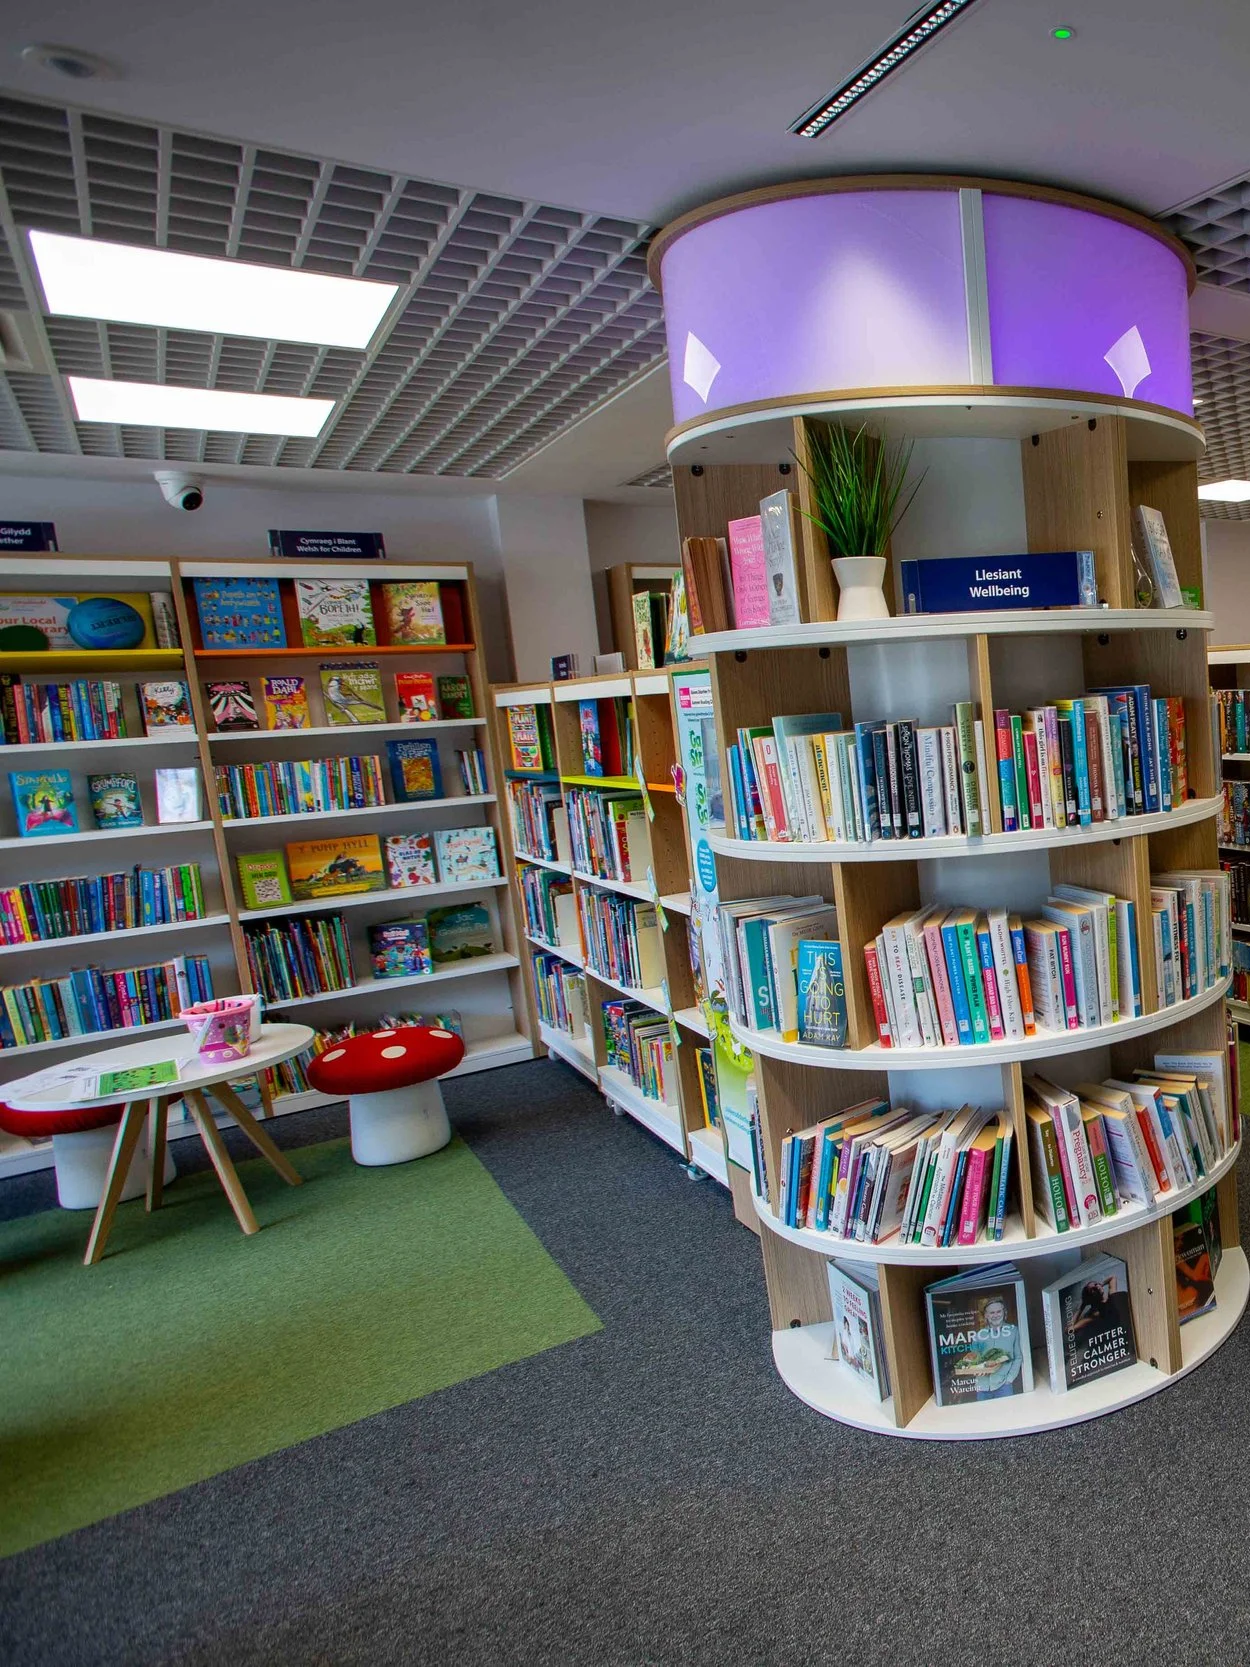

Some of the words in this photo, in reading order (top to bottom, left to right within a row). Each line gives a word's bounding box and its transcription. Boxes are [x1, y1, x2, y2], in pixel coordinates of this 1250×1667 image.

[300, 538, 333, 547] Cymraeg
[337, 538, 357, 546] Blant
[975, 568, 1022, 581] Llesiant
[969, 584, 1030, 599] Wellbeing
[23, 616, 57, 625] Local
[270, 679, 299, 688] ROALD
[272, 685, 301, 696] DAHL
[1128, 695, 1136, 717] ADAM
[1075, 703, 1083, 742] Mindfulness
[1129, 717, 1137, 740] PEATY
[923, 735, 935, 769] Mindful
[1000, 730, 1008, 758] COMFORT
[946, 750, 955, 792] PERFORMANCE
[907, 934, 915, 954] CELERY
[1014, 937, 1022, 950] Allen
[807, 951, 836, 967] THIS
[893, 944, 899, 953] TO
[898, 974, 906, 1000] DISEASE
[800, 981, 844, 998] GOING
[969, 975, 978, 994] POWER
[814, 997, 831, 1010] TO
[972, 994, 980, 1008] PLAN
[803, 1010, 840, 1026] HURT
[803, 1032, 822, 1041] ADAM
[823, 1033, 841, 1042] KAY
[841, 1146, 850, 1174] Breasts
[1072, 1130, 1088, 1180] Pregnancy
[862, 1181, 870, 1202] Prostate
[859, 1202, 868, 1220] Cancer
[1064, 1295, 1077, 1340] GOULDING
[1088, 1326, 1127, 1347] FITTER.
[940, 1341, 985, 1355] KITCHEN
[1069, 1341, 1078, 1367] ELLIE
[1083, 1337, 1128, 1359] CALMER.
[1070, 1348, 1130, 1377] STRONGER.
[950, 1384, 981, 1395] Wareing
[951, 1377, 979, 1387] Marcus
